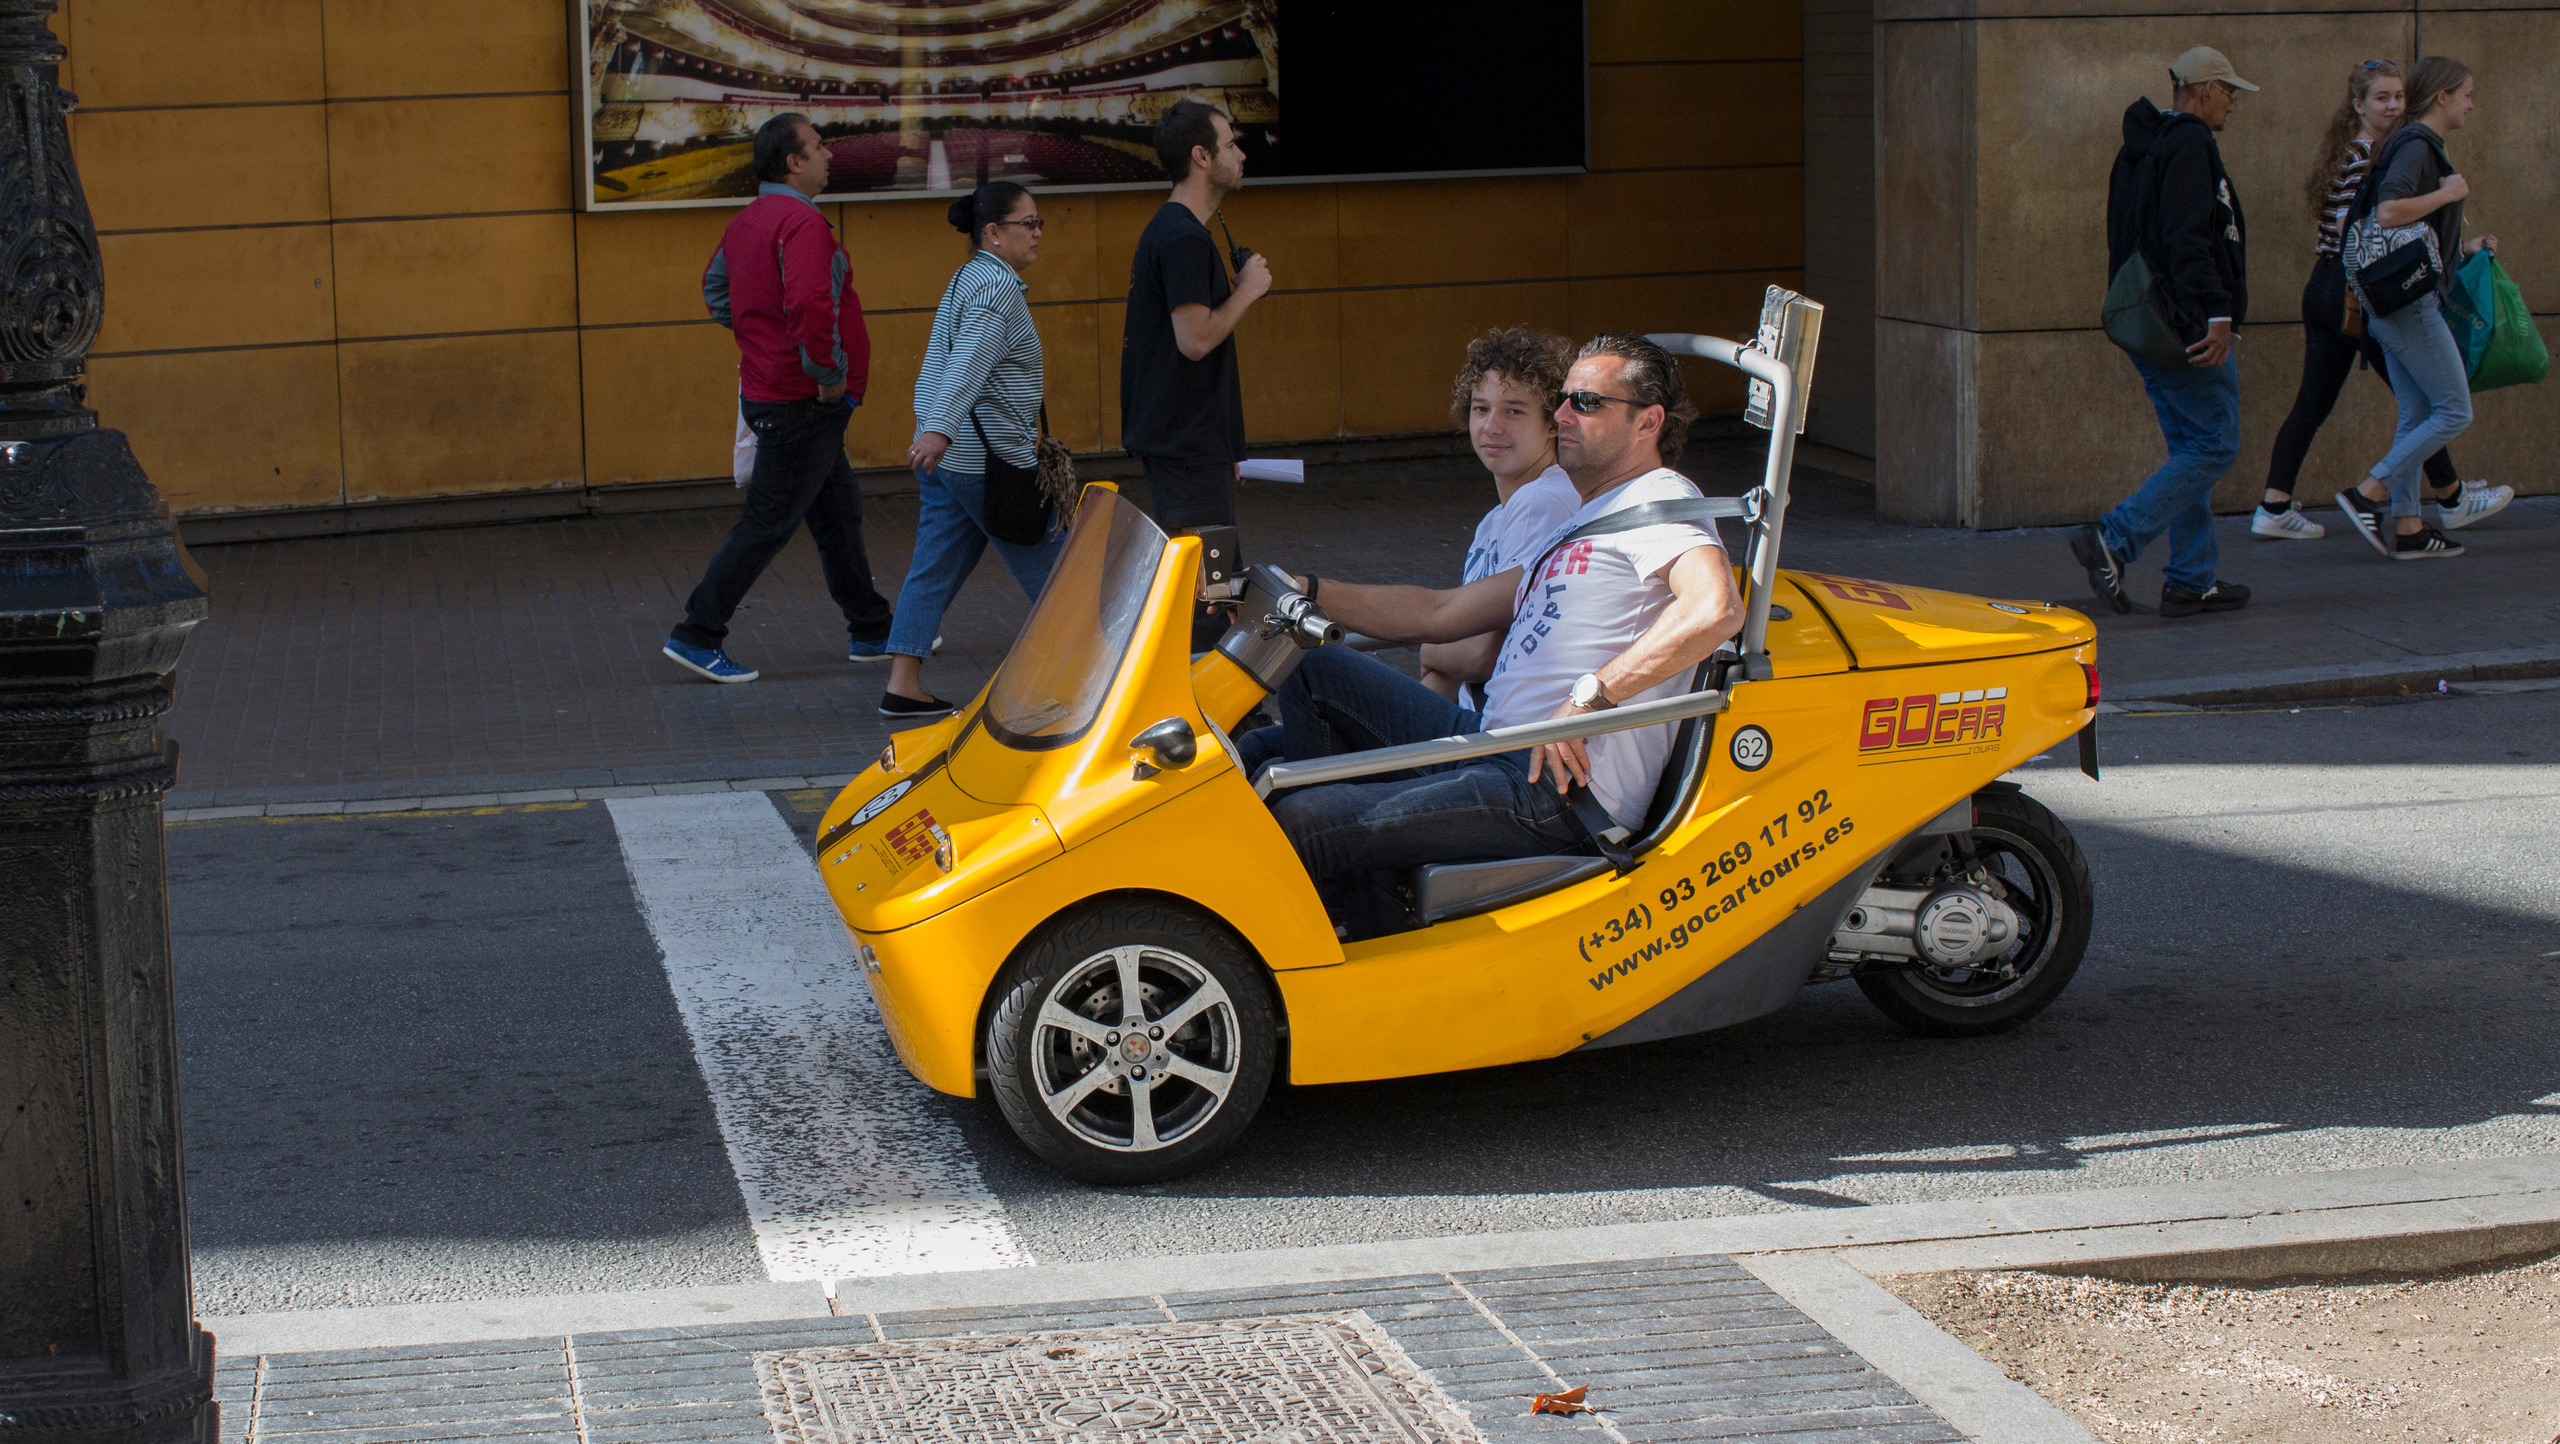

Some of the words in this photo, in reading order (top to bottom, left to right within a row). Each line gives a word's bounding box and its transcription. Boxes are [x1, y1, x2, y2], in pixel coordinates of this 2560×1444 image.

[1737, 736, 1764, 759] 62
[1967, 744, 2001, 755] TOURS
[864, 787, 899, 820] 62
[1578, 903, 1652, 963] (+34)
[1659, 877, 1696, 911] 93
[1700, 841, 1753, 887] 269
[1759, 813, 1789, 848] 17
[1797, 788, 1833, 824] 92
[1588, 815, 1855, 991] www.gocartours.es
